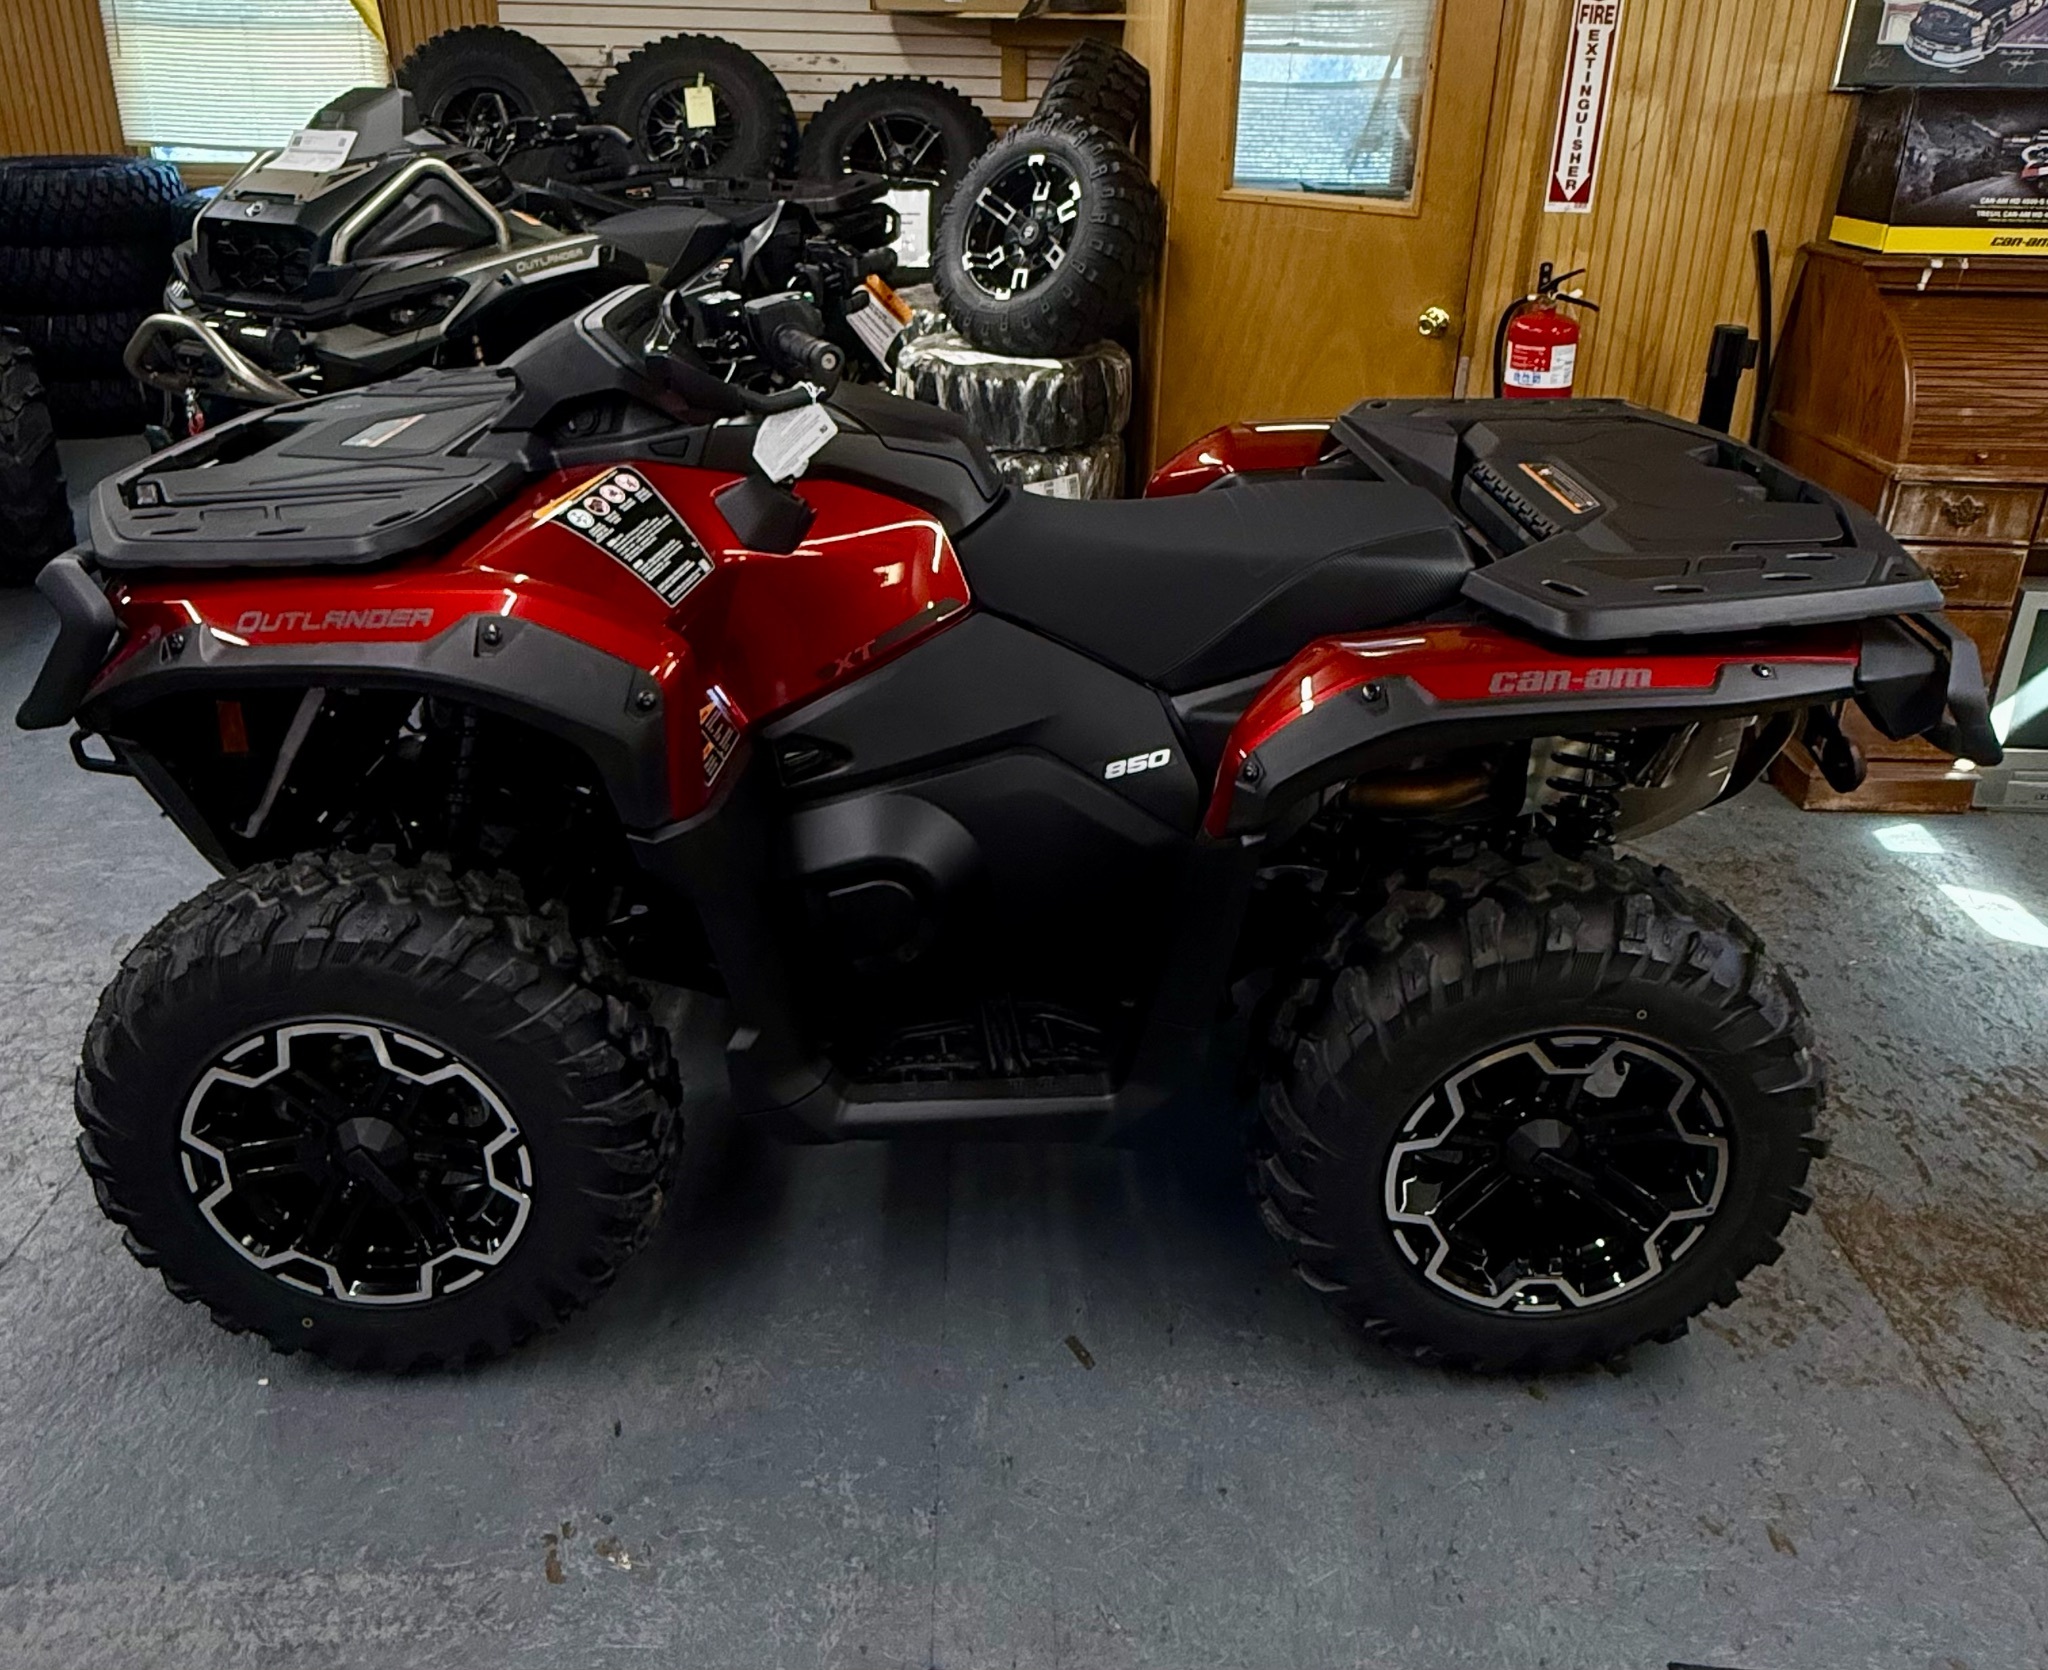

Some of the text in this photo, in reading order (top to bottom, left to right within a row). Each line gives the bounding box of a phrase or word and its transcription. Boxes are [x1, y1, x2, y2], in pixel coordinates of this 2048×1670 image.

[1580, 4, 1615, 25] FIRE
[1565, 29, 1600, 191] EXTINGUISHER
[516, 247, 584, 272] OUTLANDER
[236, 608, 434, 633] OUTLANDER
[835, 639, 876, 676] XT
[1488, 667, 1652, 694] can-am
[1104, 748, 1171, 780] 850
